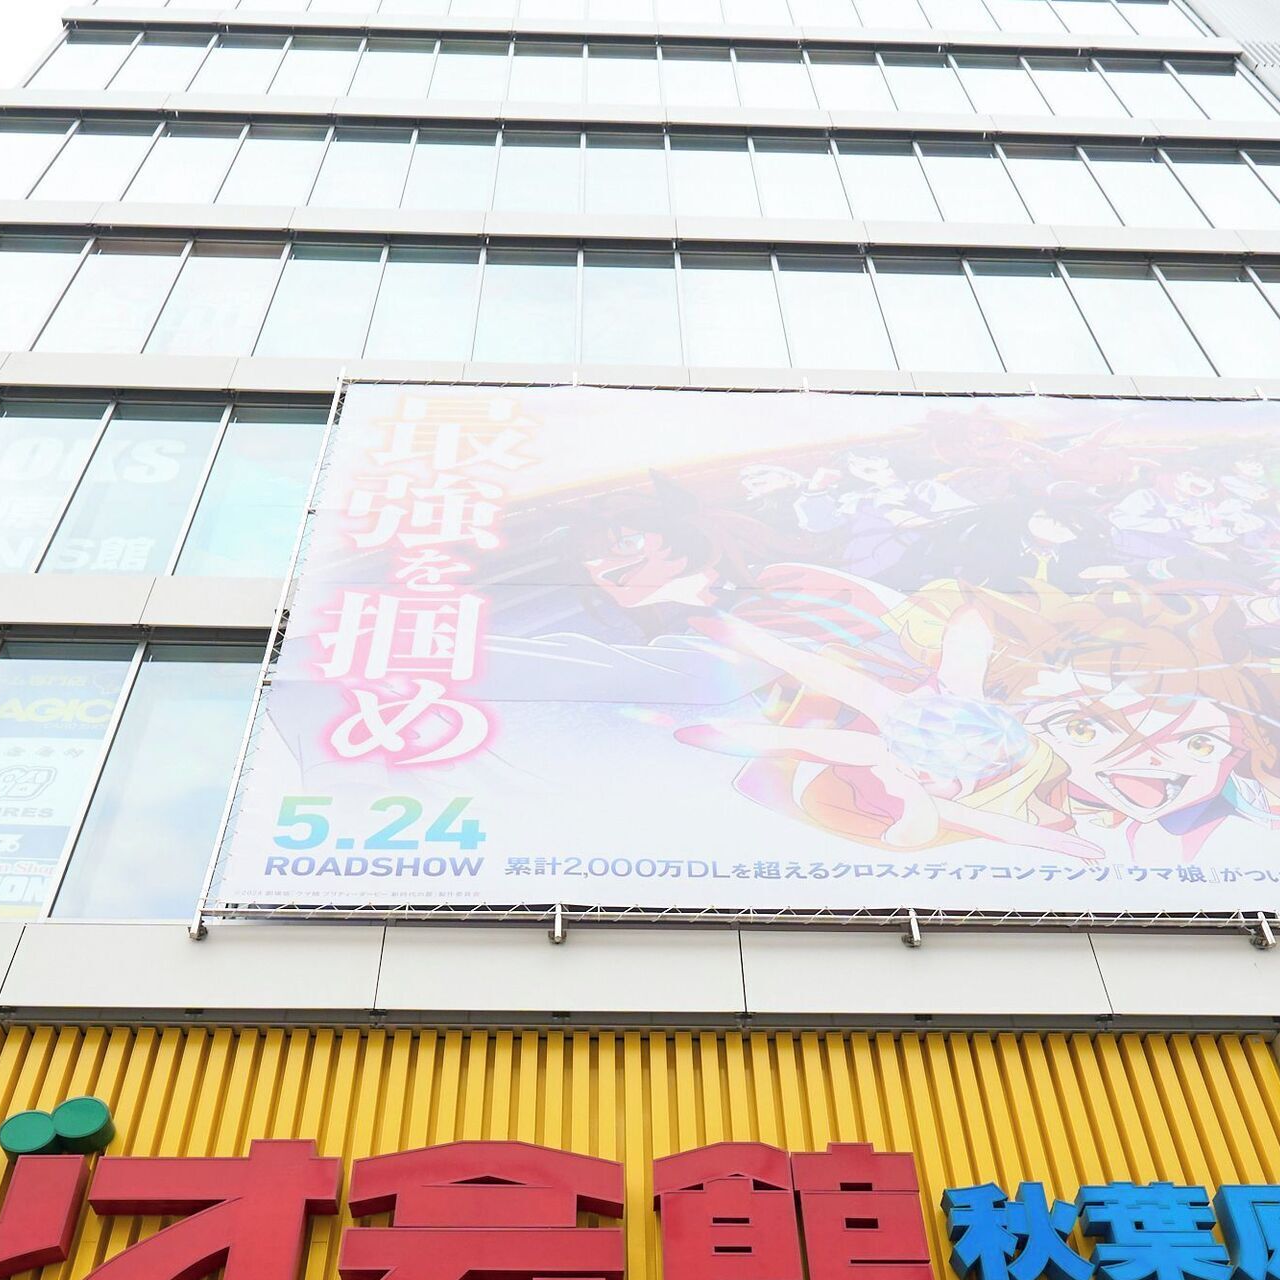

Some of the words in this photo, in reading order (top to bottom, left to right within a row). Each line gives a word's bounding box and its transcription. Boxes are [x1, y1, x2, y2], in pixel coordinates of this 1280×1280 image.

[320, 396, 544, 768] 最強を掴め
[272, 793, 487, 853] 5.24
[263, 856, 486, 877] ROADSHOW
